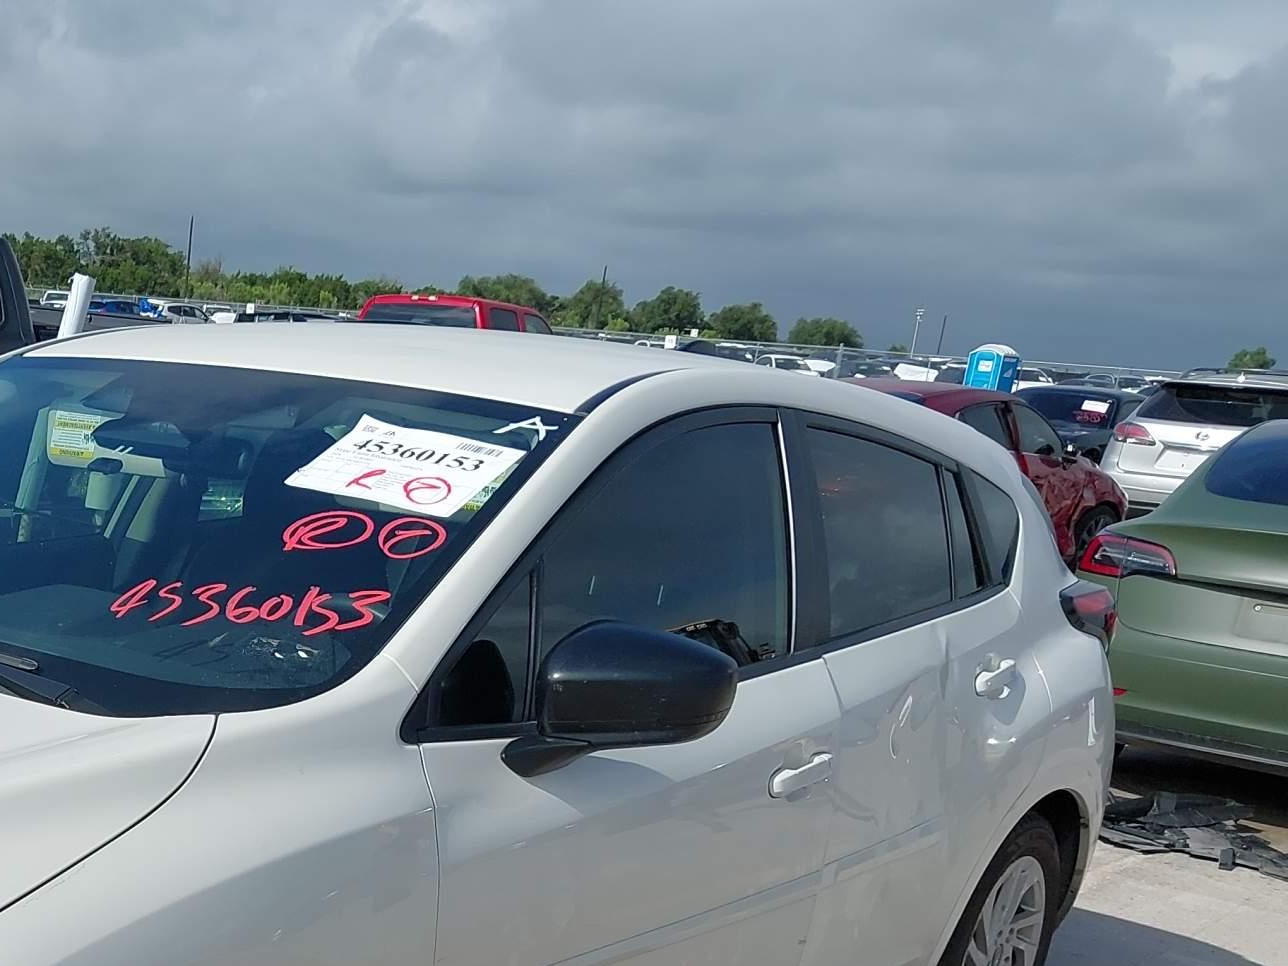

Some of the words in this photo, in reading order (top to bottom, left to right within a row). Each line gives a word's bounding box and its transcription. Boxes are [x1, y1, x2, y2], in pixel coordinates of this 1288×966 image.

[493, 416, 559, 441] A
[353, 439, 485, 471] 45360153
[110, 579, 392, 636] 45360153
